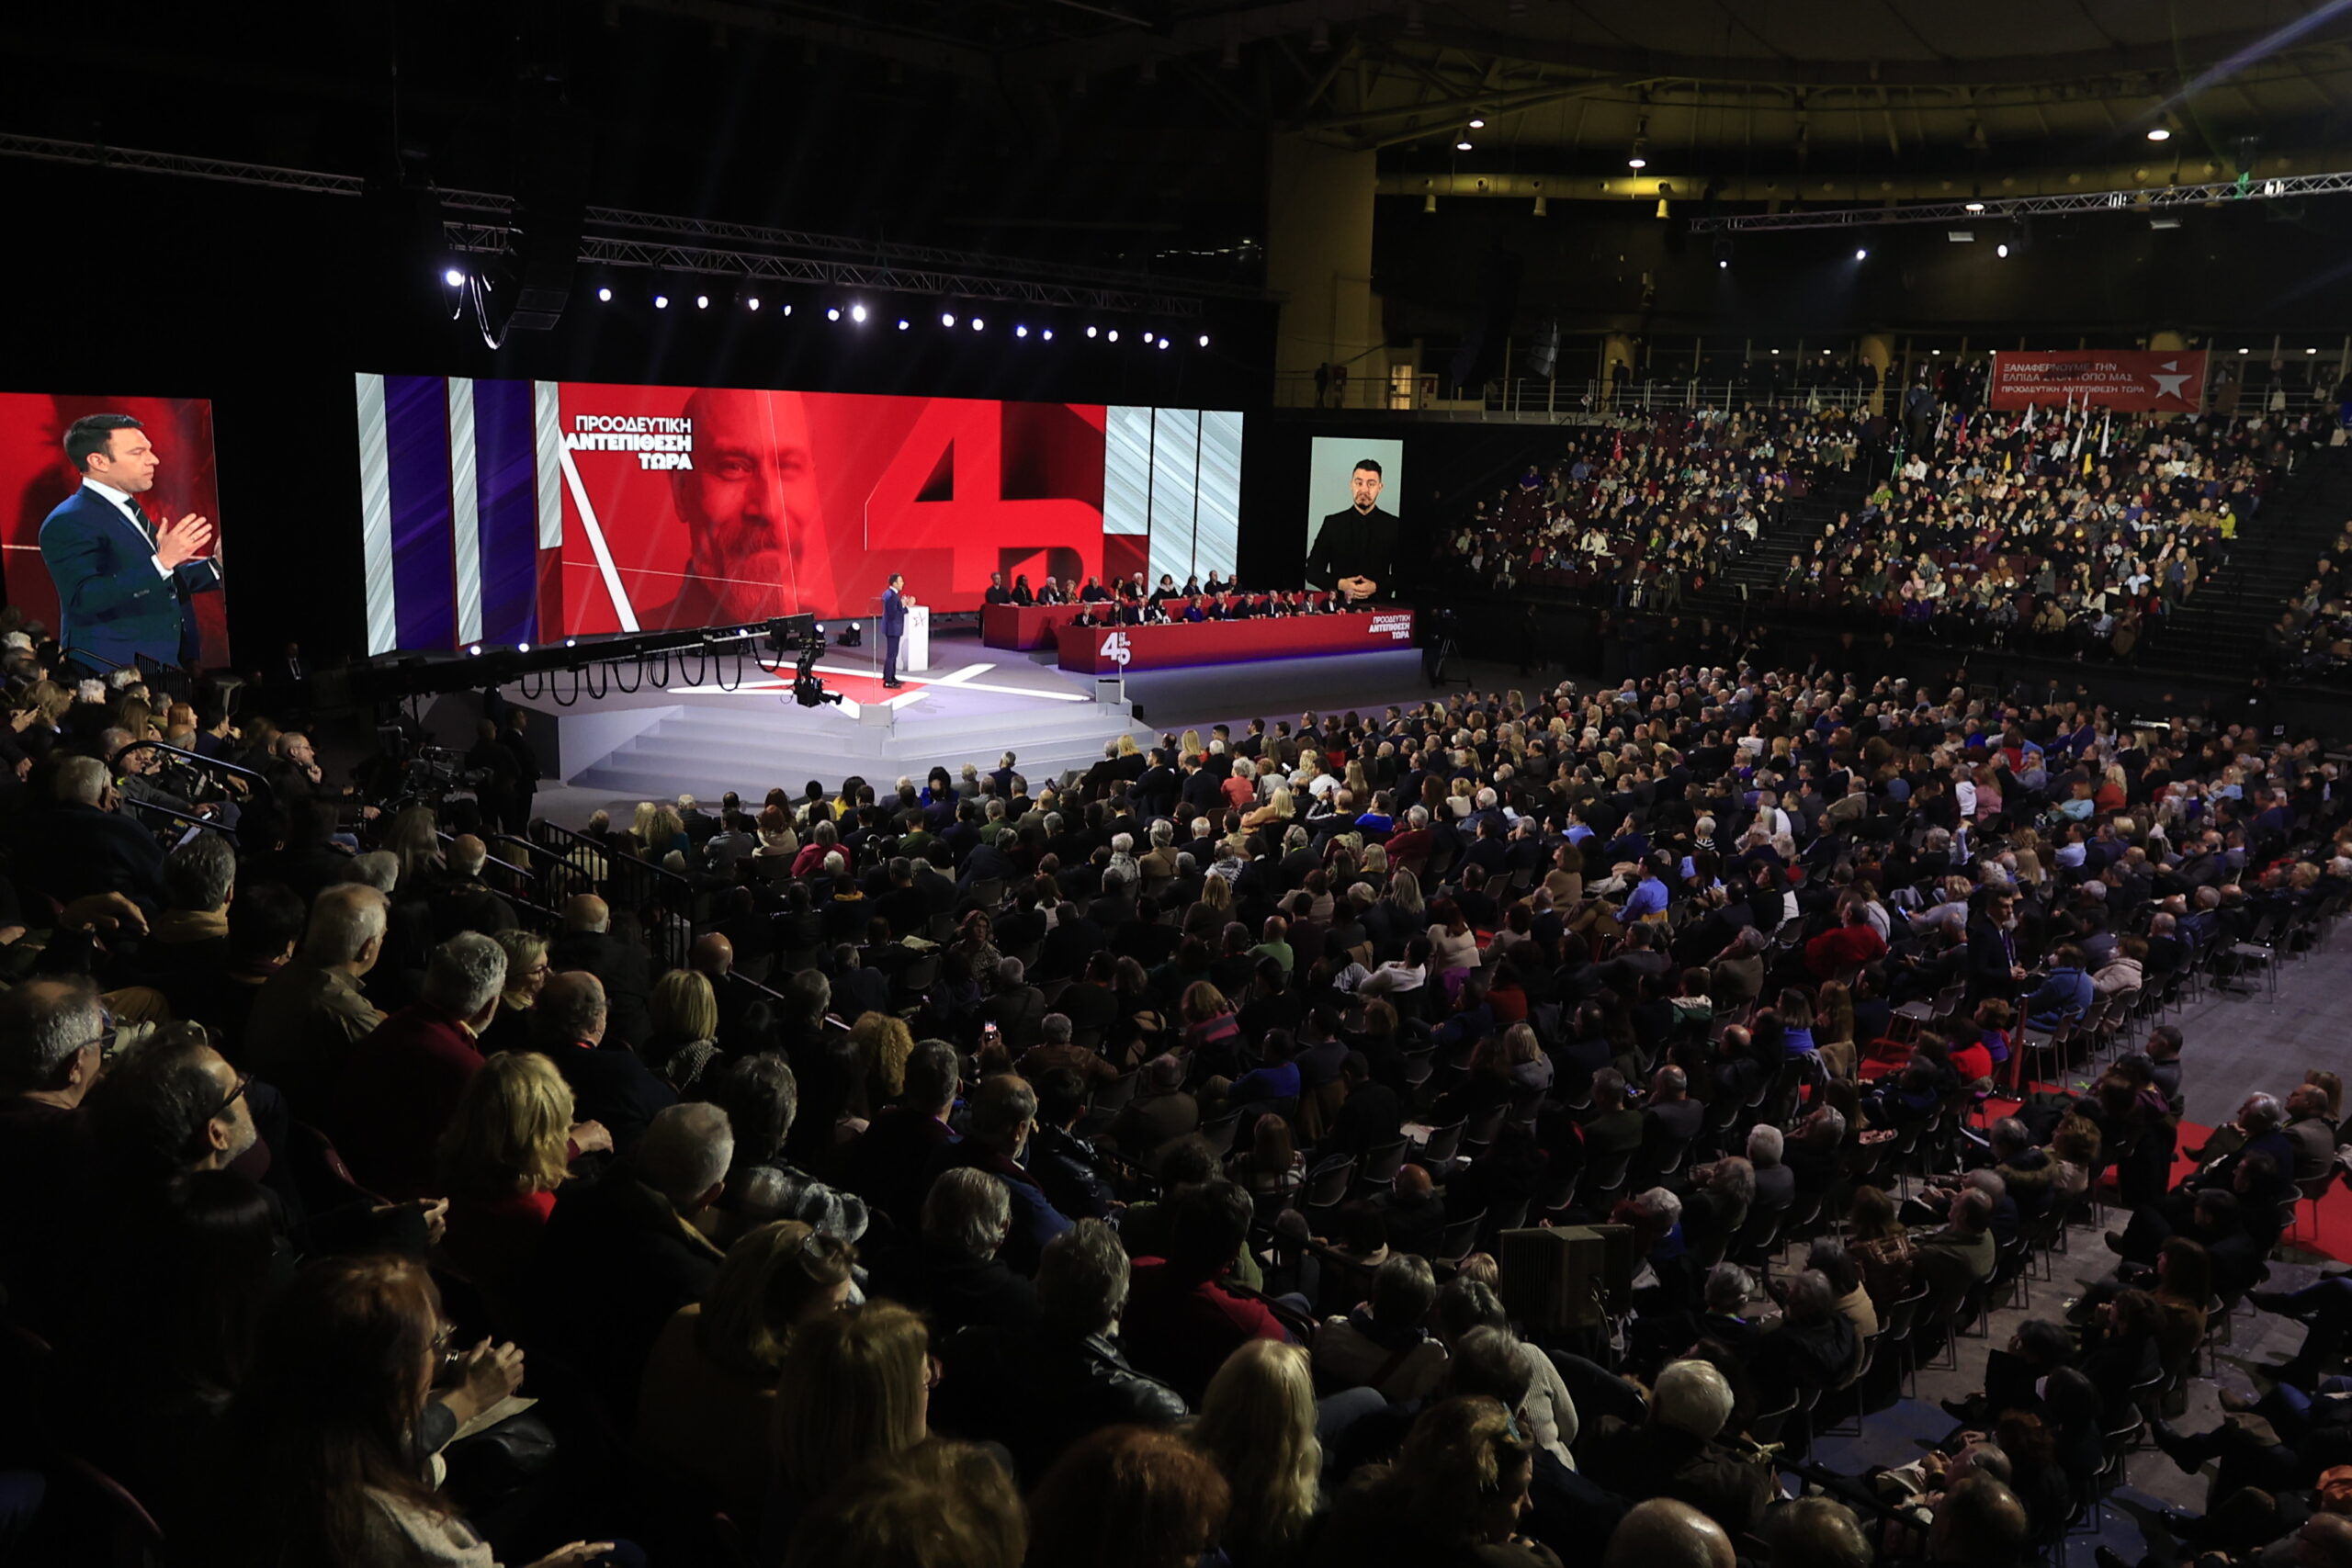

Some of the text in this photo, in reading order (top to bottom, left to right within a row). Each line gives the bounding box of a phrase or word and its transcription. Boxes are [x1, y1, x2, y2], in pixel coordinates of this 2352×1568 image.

[2003, 362, 2117, 372] ΞΑΝΑΦΕΡΝΟΥΜΕ ΤΗΝ
[2003, 373, 2041, 382] ΕΛΠΙΔΑ
[2109, 373, 2133, 382] ΜΑΣ
[2001, 385, 2145, 393] ΠΡΟΟΔΕΥΤΙΚΗ ΑΝΤΕΠΙΘΕΣΗ ΤΩΡΑ
[575, 415, 692, 433] ΠΡΟΟΔΕΥΤΙΚΗ
[564, 433, 692, 452] ΑΝΤΕΠΙΘΕΣΗ
[638, 453, 694, 470] ΤΩΡΑ
[1373, 615, 1411, 624] ΠΡΟΟΔΕΥΤΙΚΗ
[1368, 622, 1410, 632] ΑΝΤΕΠΙΘΕΣΗ
[1391, 631, 1409, 639] ΤΩΡΑ
